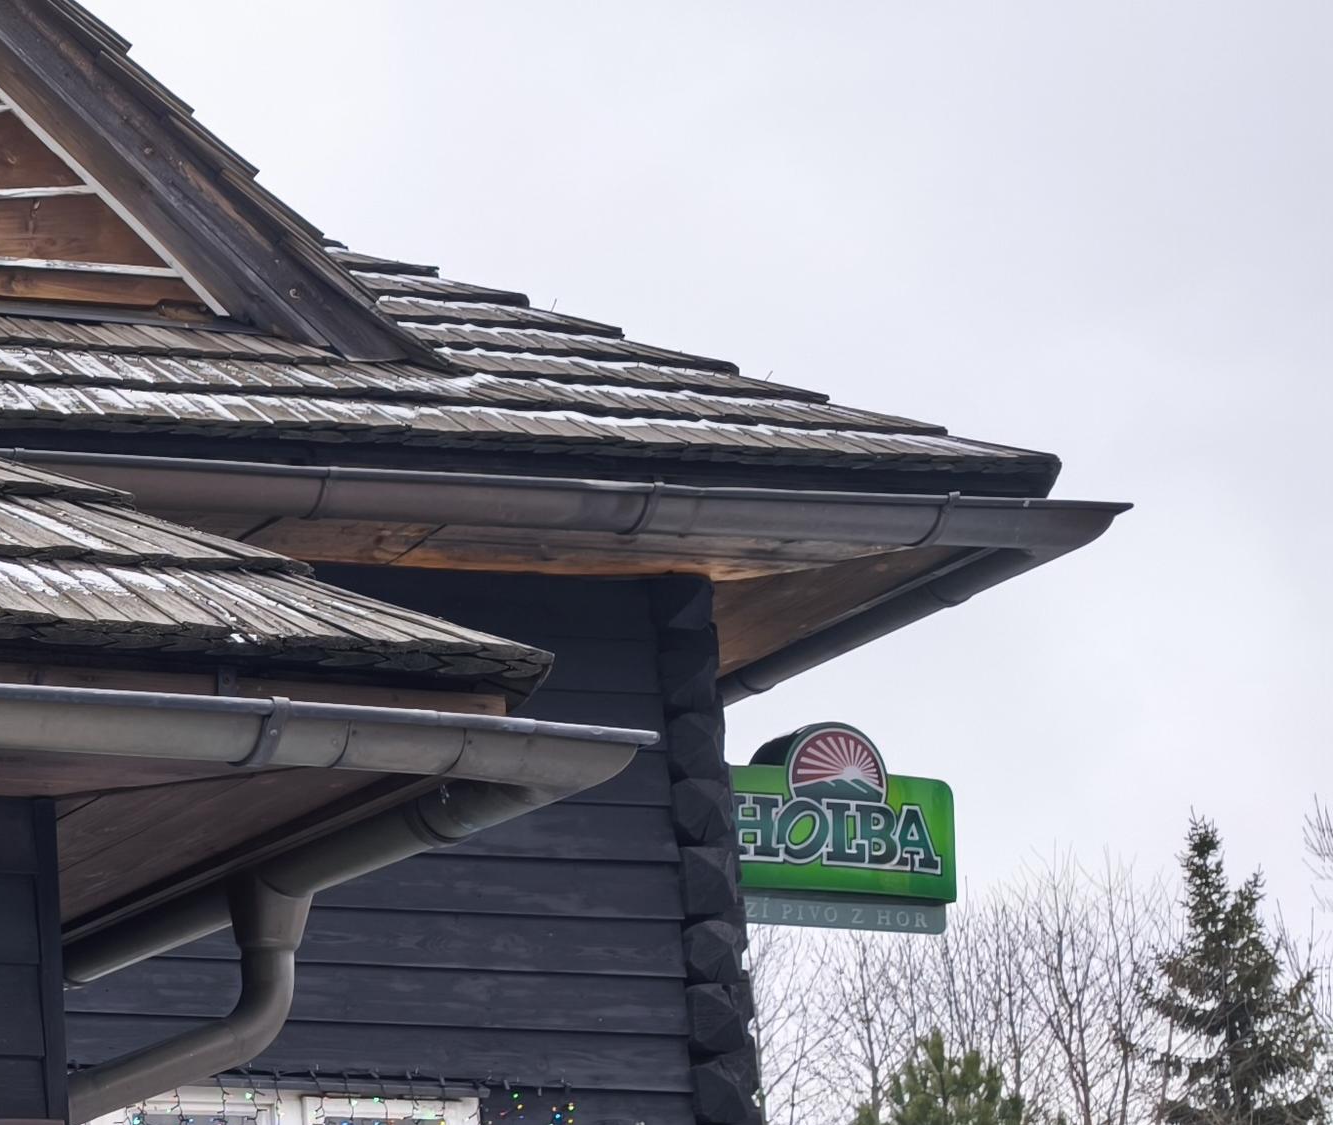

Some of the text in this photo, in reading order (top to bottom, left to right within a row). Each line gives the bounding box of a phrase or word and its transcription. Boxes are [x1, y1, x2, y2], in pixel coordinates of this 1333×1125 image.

[734, 793, 943, 876] HOLBA
[782, 902, 838, 924] PIVO
[851, 908, 865, 925] Z
[876, 911, 929, 929] HOR
